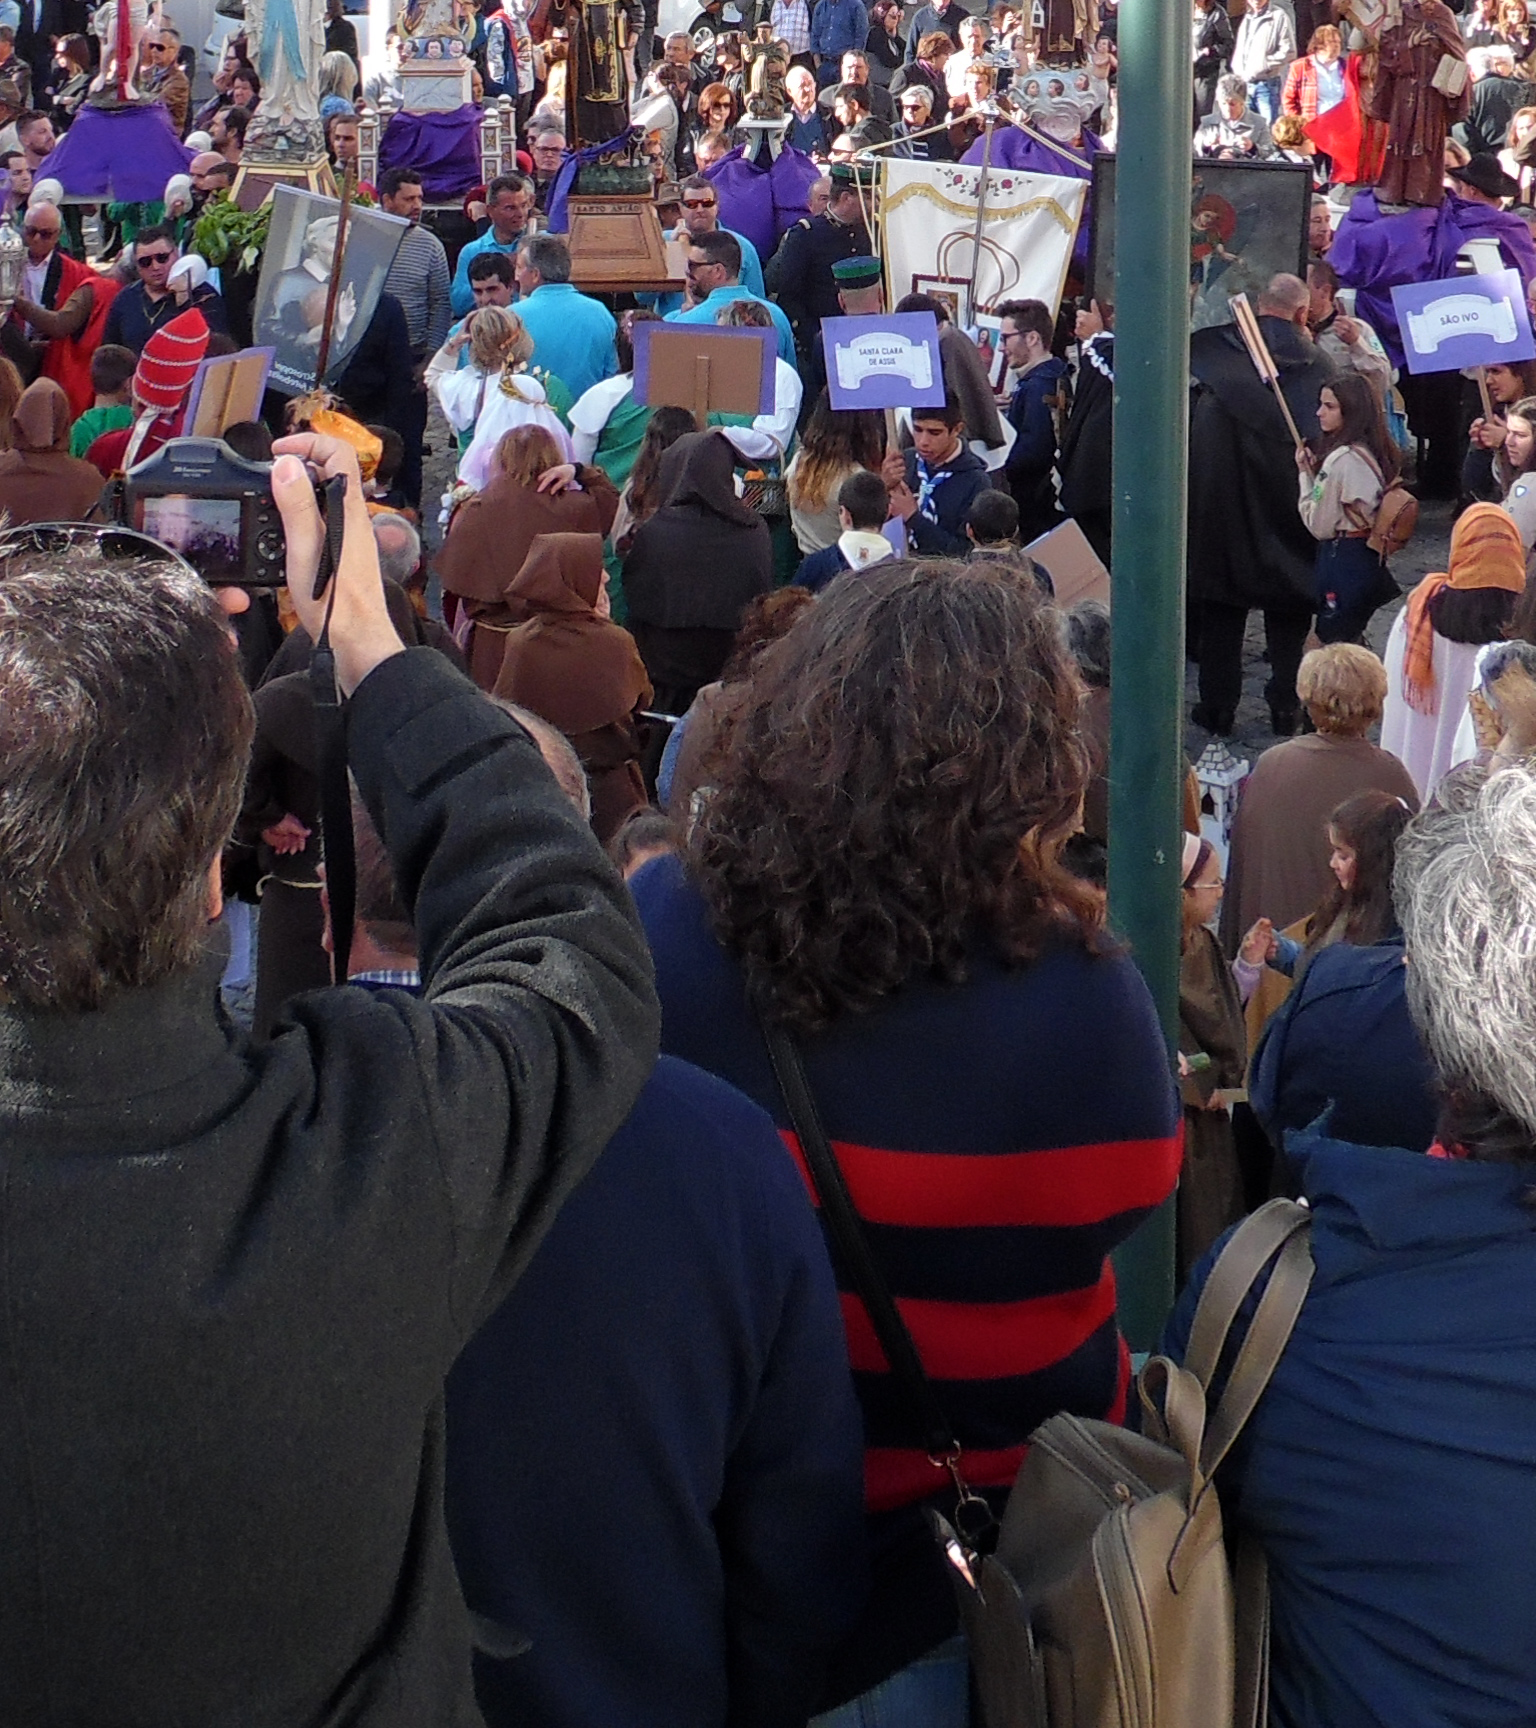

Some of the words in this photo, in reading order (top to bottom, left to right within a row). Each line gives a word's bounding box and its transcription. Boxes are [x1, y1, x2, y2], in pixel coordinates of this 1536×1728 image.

[1440, 314, 1460, 326] SÃO
[1462, 312, 1479, 322] IVO
[881, 347, 904, 355] CLARA
